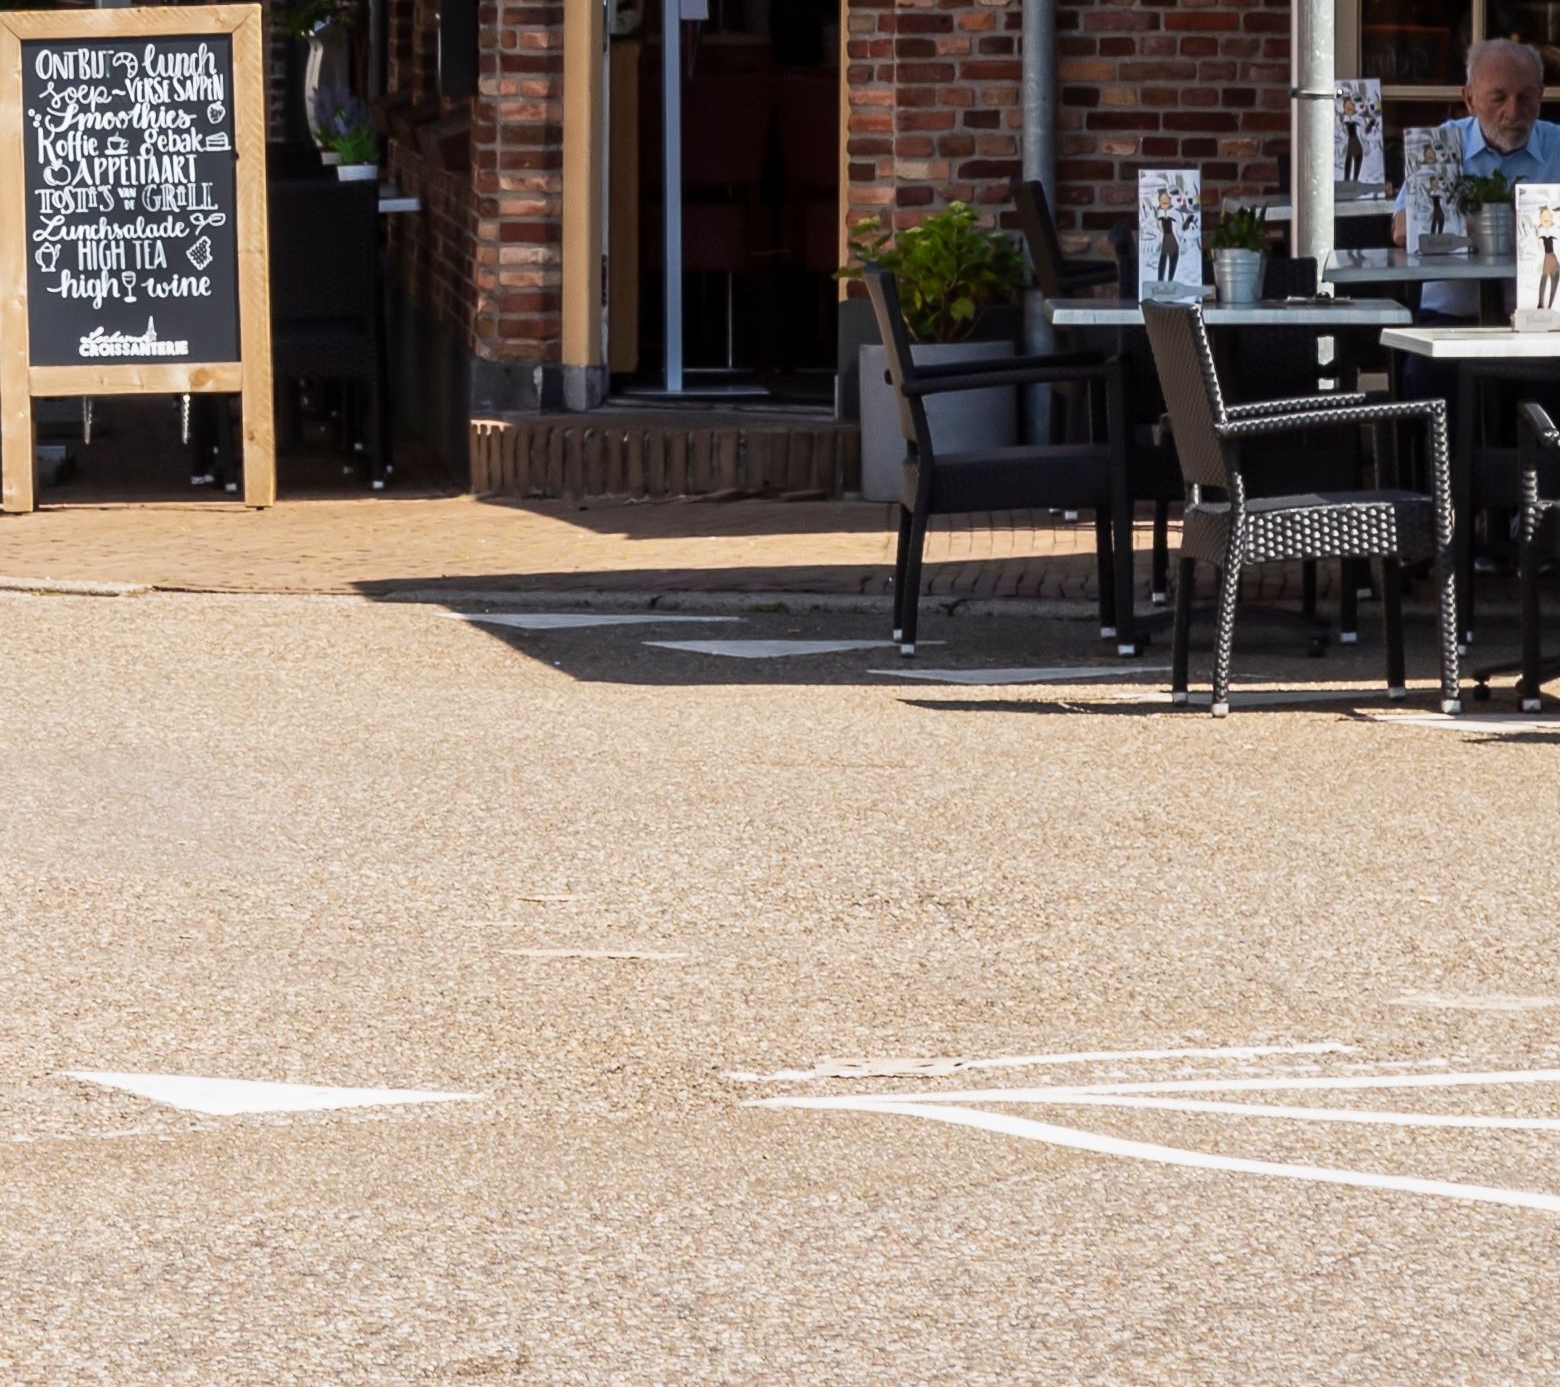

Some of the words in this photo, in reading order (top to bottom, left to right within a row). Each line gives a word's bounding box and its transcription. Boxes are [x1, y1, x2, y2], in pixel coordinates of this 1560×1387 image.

[142, 43, 218, 77] lunch
[38, 81, 113, 113] soep
[125, 76, 172, 105] VERSE
[44, 103, 198, 133] Smoothies
[37, 127, 100, 164] Koffie
[139, 127, 204, 159] gebak
[71, 154, 197, 186] APPELTAART
[141, 182, 219, 213] GRILL
[32, 215, 191, 242] Lunchsalade
[77, 240, 126, 271] HIGH
[132, 239, 168, 269] TEA
[46, 268, 121, 310] high
[140, 274, 212, 298] wine
[79, 340, 189, 357] CROISSANTERIE
